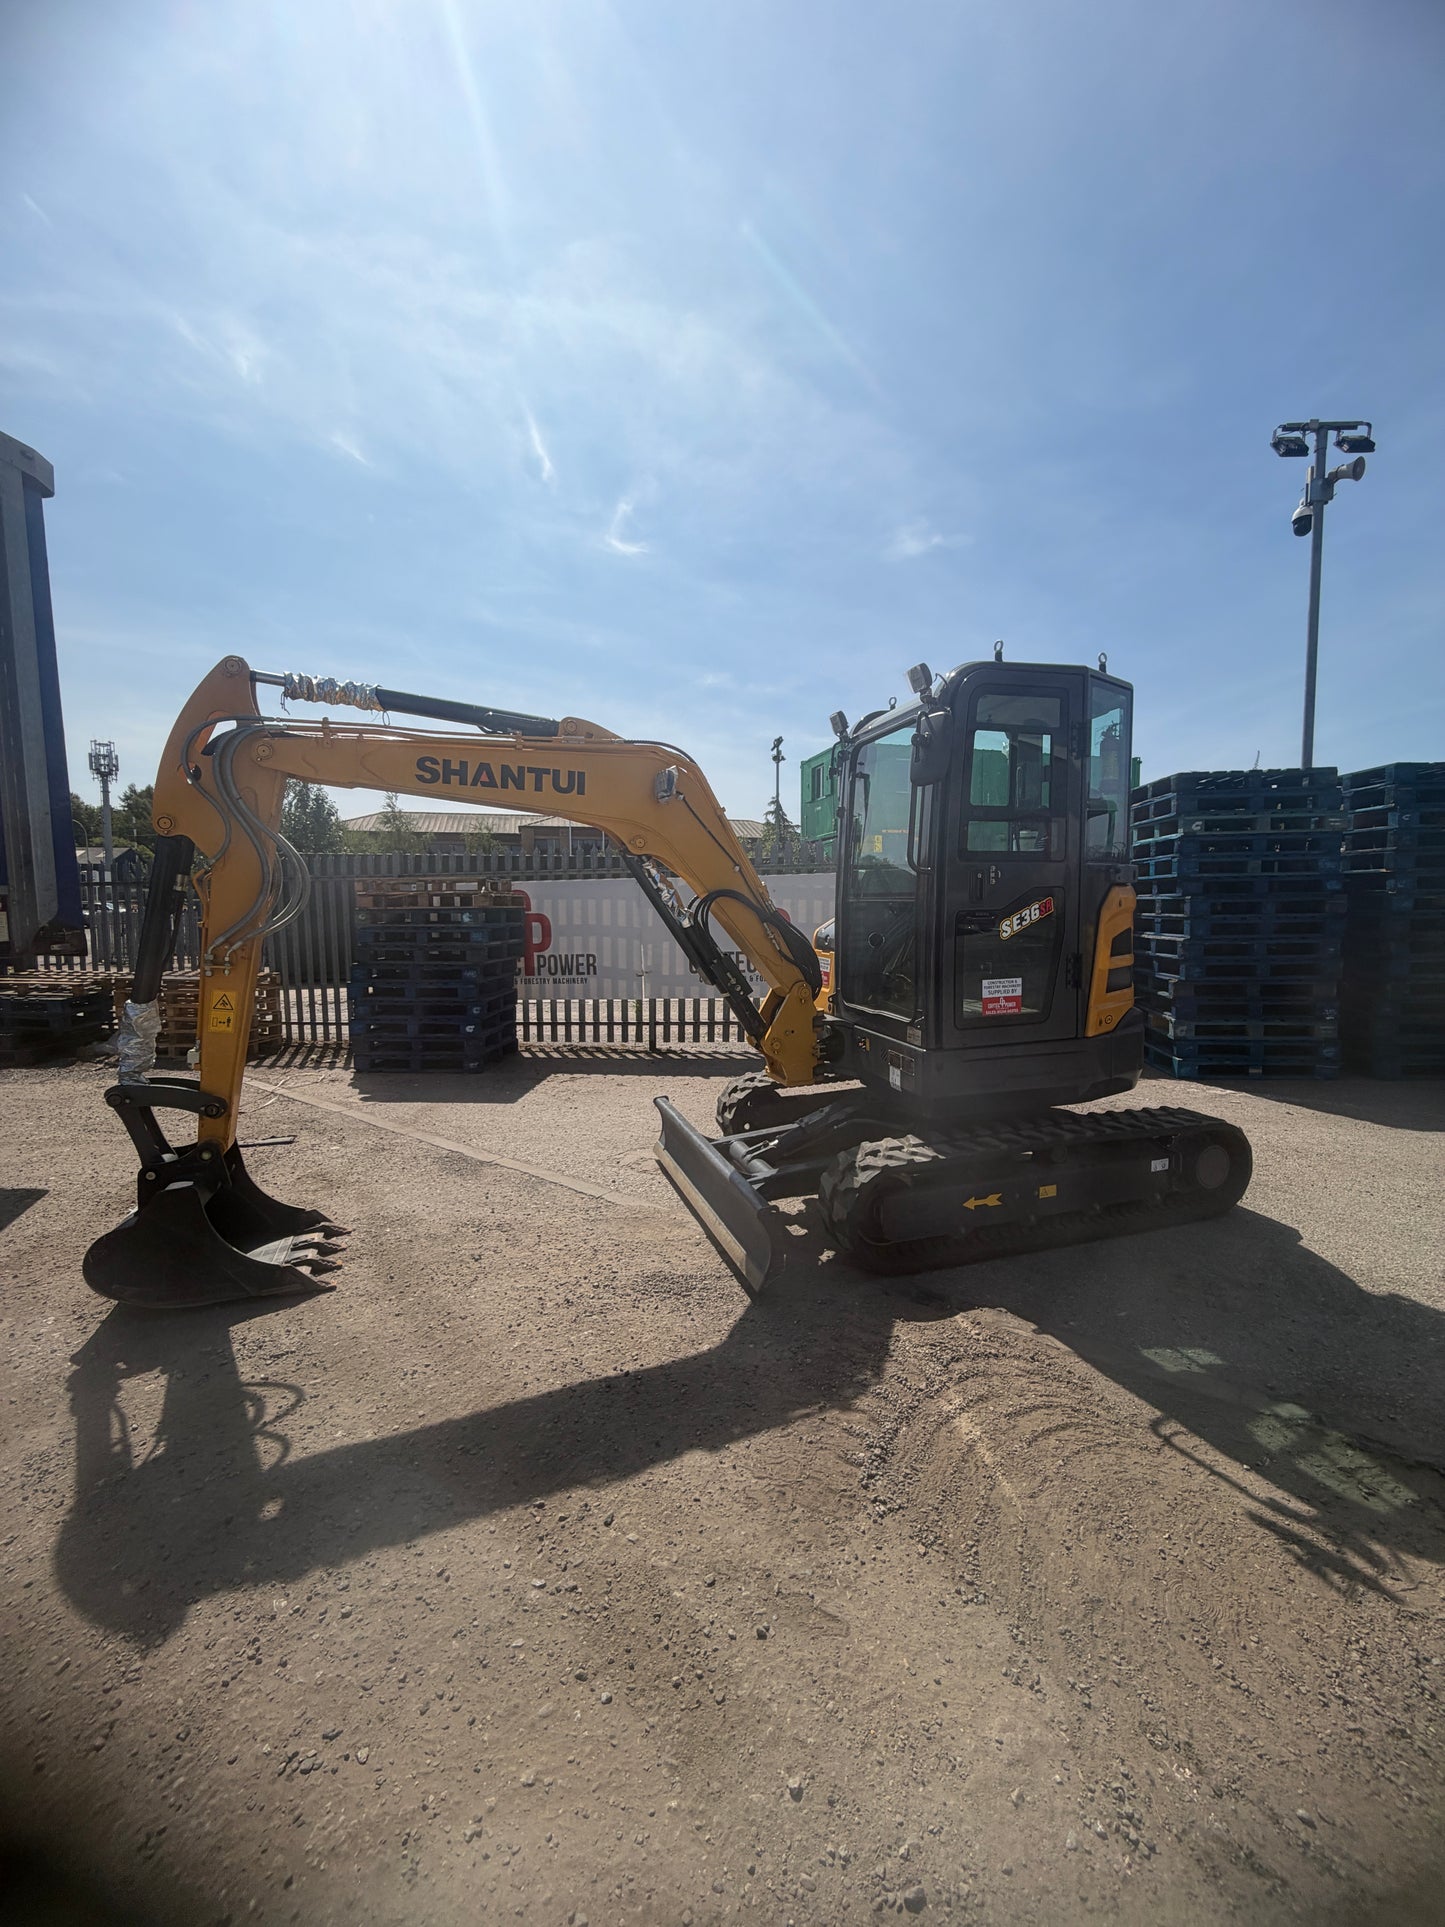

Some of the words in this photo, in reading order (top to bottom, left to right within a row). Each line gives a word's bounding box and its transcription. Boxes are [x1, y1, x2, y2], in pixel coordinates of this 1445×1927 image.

[415, 756, 586, 795] SHANTUI
[537, 953, 597, 976] POWER
[521, 977, 550, 985] FORESTRY
[553, 977, 588, 985] MACHINERY
